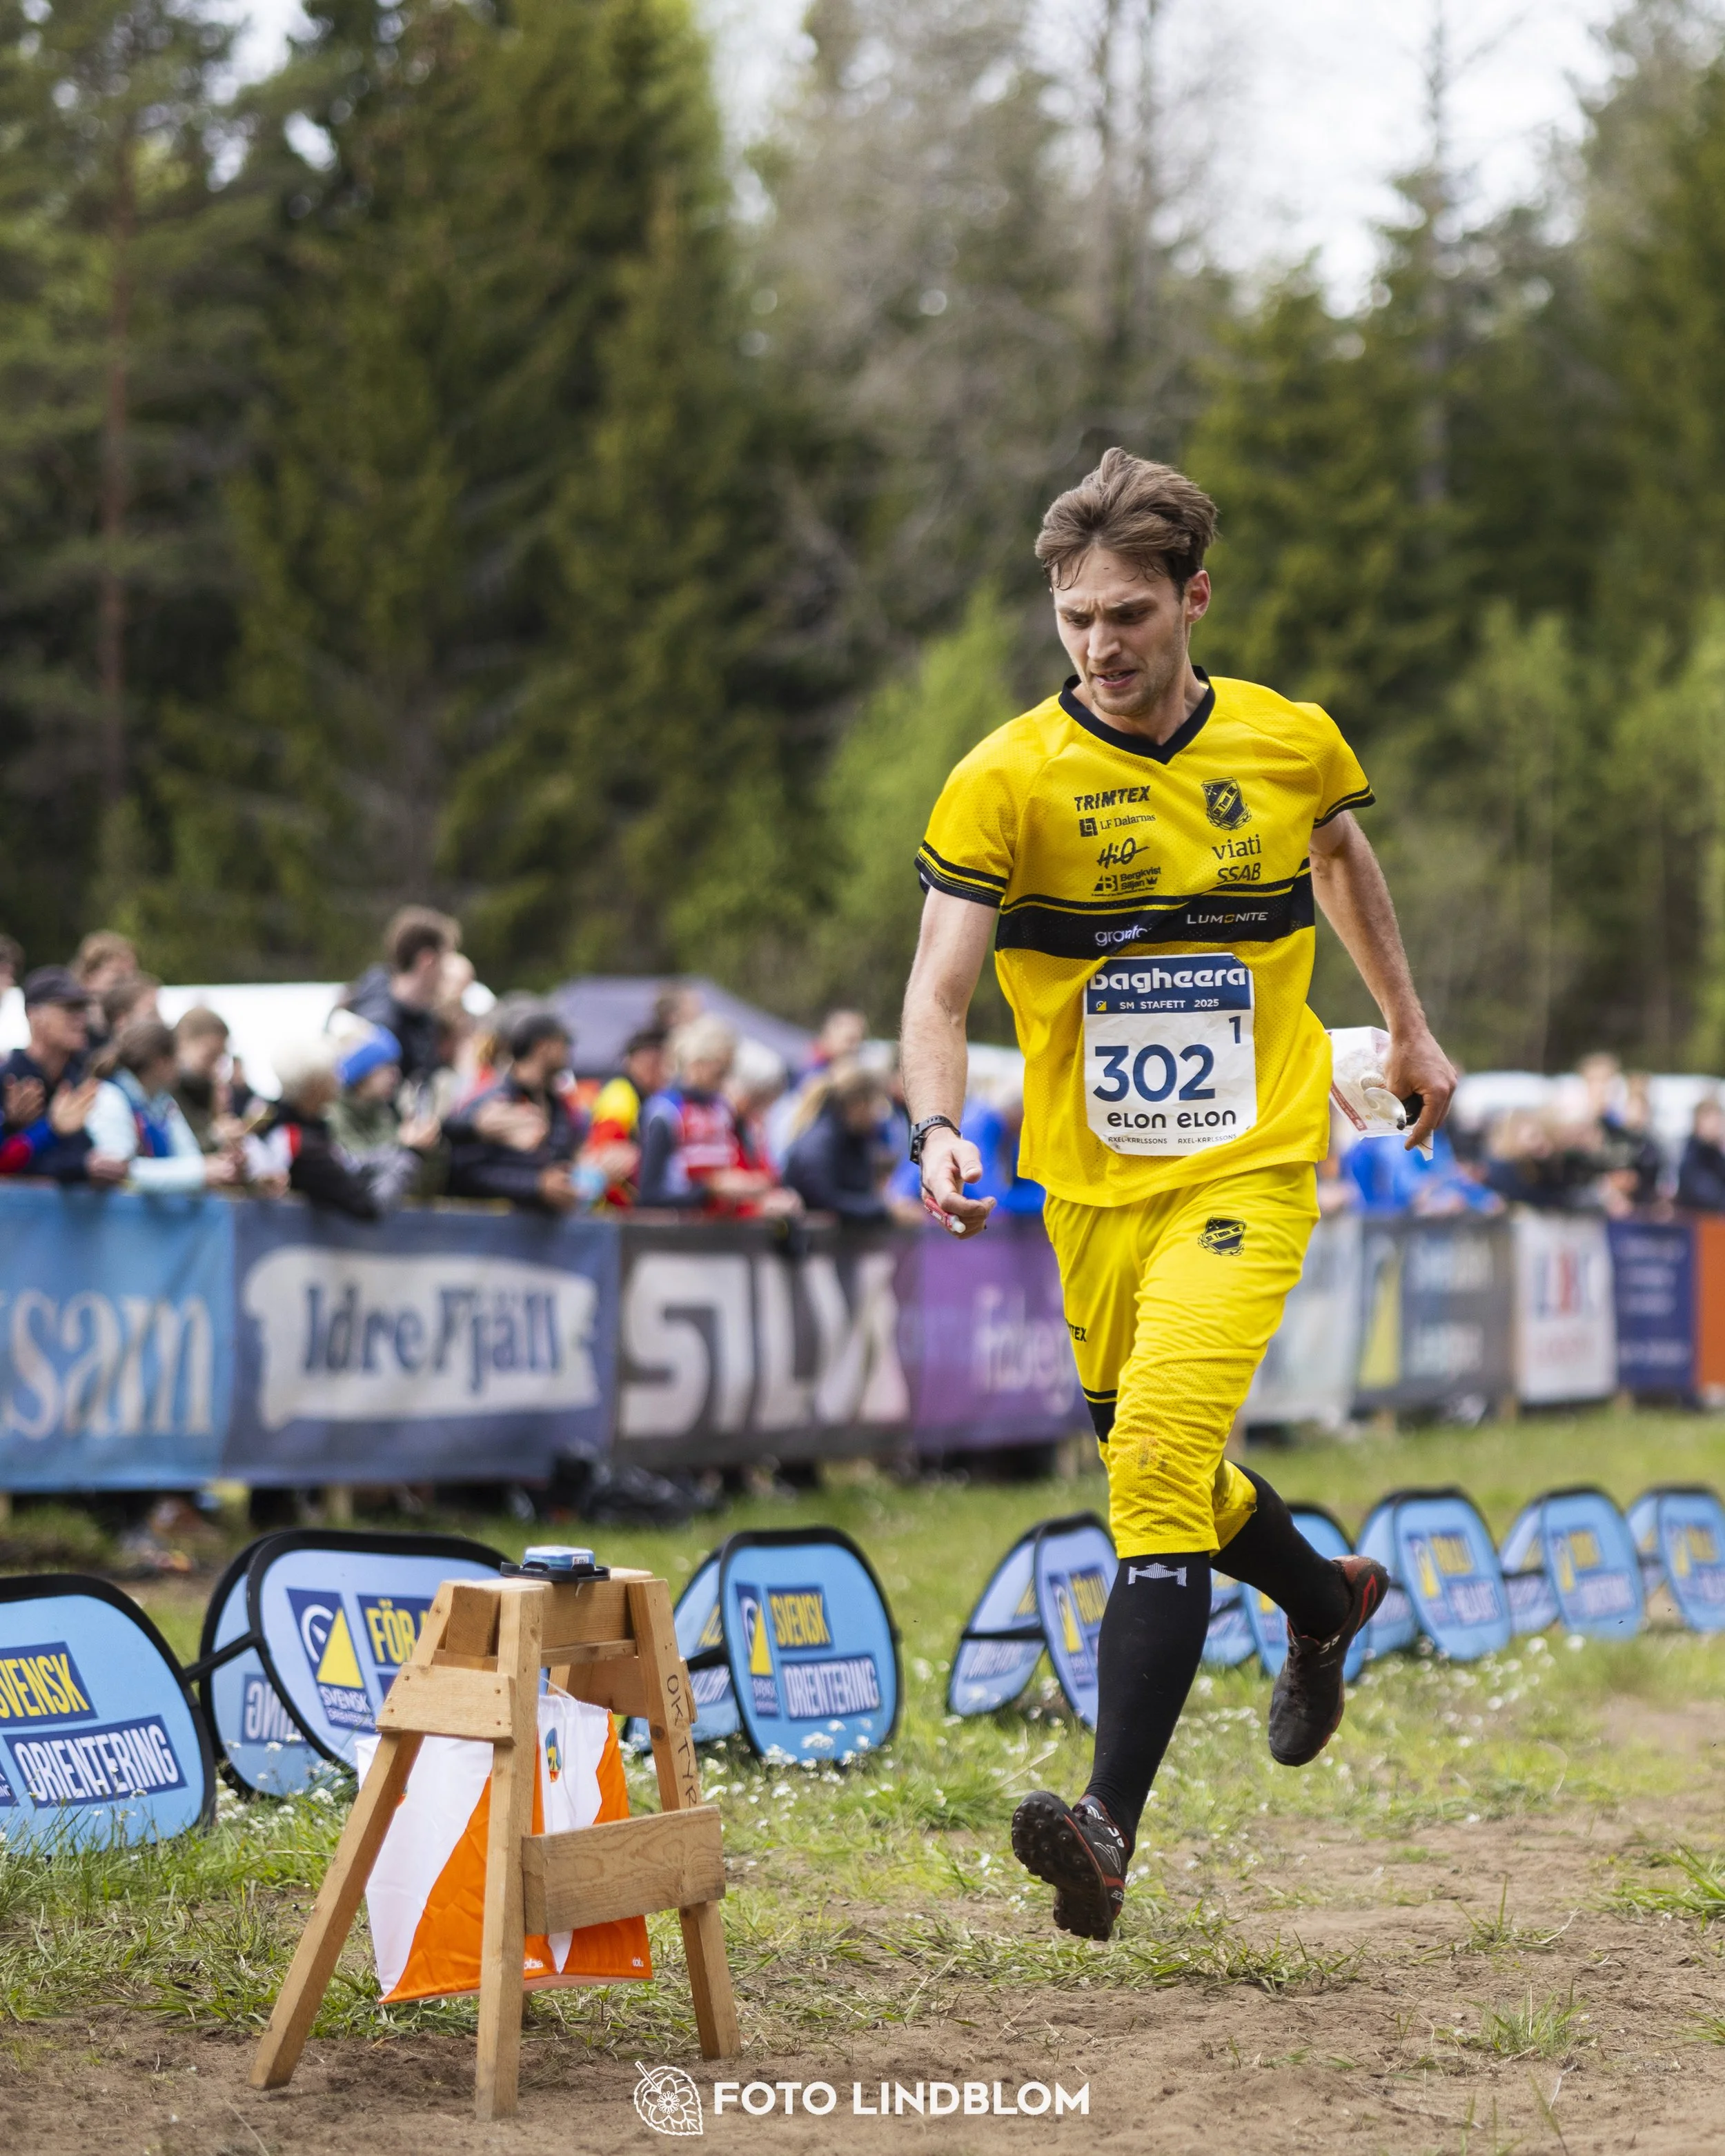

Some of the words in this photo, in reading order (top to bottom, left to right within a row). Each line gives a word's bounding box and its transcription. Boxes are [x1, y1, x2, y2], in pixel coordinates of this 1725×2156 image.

[1074, 785, 1151, 812] TRIMTEX
[1099, 819, 1113, 830] LF
[1114, 814, 1157, 828] Dalarnas
[1211, 833, 1262, 860] viati
[1120, 867, 1161, 882] Bergkvist
[1121, 880, 1145, 891] Siljan
[1216, 862, 1262, 885] SSAB
[1186, 911, 1268, 924] LUMONITE
[1089, 967, 1247, 994] bagheera
[1119, 1001, 1135, 1010] SM
[1140, 1000, 1186, 1009] STAFETT
[1193, 998, 1220, 1008] 2025
[1228, 1016, 1242, 1045] 1
[1092, 1044, 1216, 1102] 302
[1107, 1136, 1168, 1145] AXEL-KARLSSONS
[0, 1287, 215, 1441] sam
[365, 1597, 418, 1664] FÖR
[769, 1592, 831, 1648] SVENSK
[667, 1674, 684, 1726] OK
[782, 1656, 880, 1719] ORIENTERING
[14, 1723, 180, 1802] ORIENTERING
